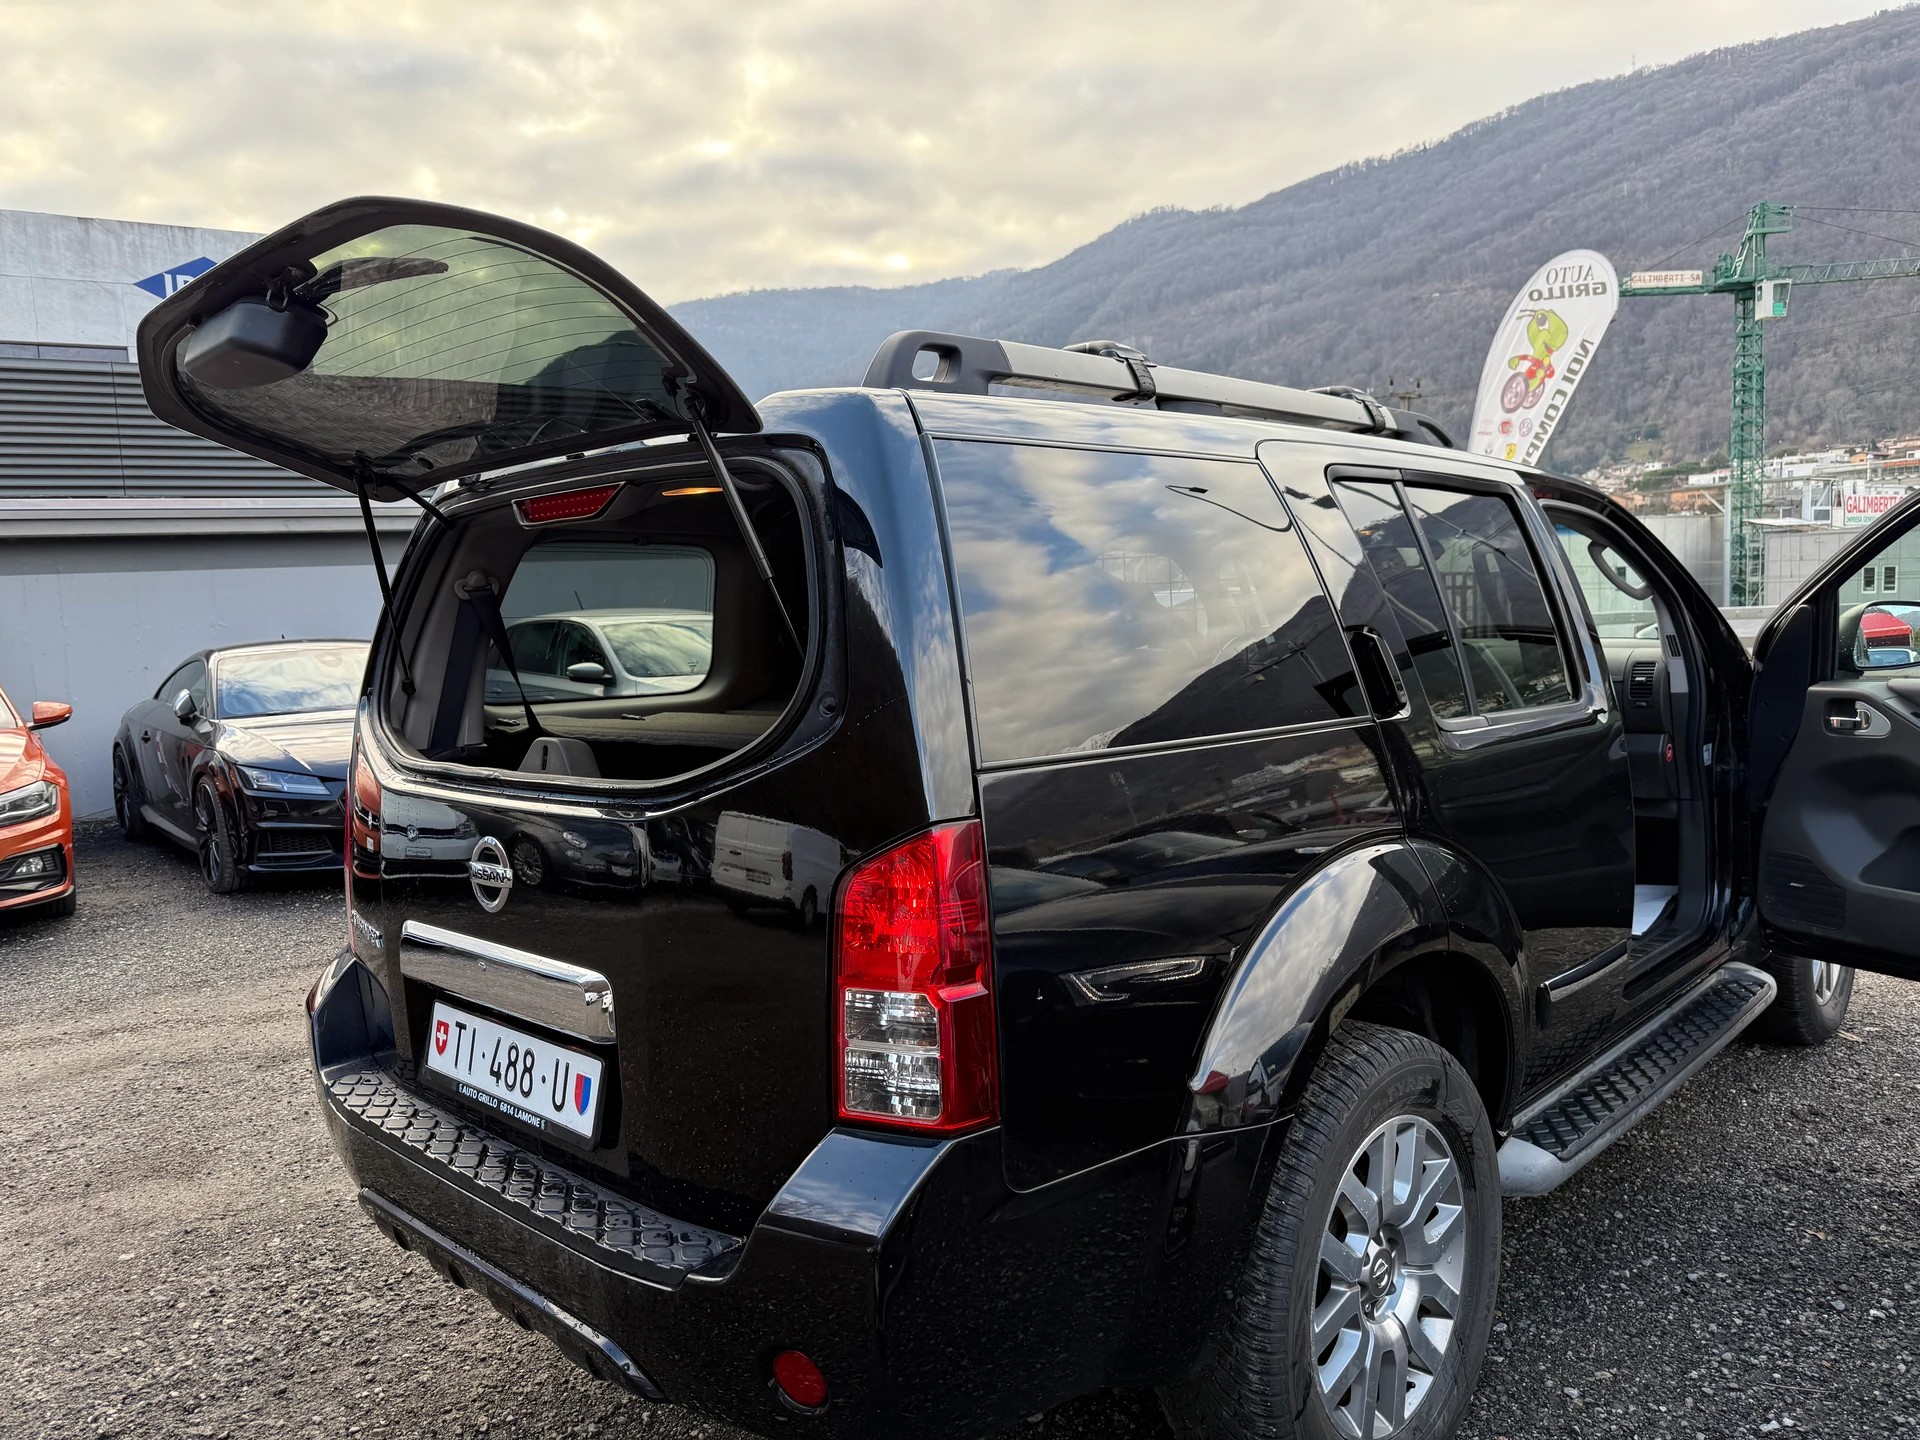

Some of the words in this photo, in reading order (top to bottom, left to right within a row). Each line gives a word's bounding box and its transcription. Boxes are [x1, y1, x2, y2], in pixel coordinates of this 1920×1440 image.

[462, 1085, 478, 1100] AUTO
[477, 1089, 499, 1108] GRILLO
[499, 1101, 515, 1117] 6814
[513, 1108, 541, 1128] LAMONE
